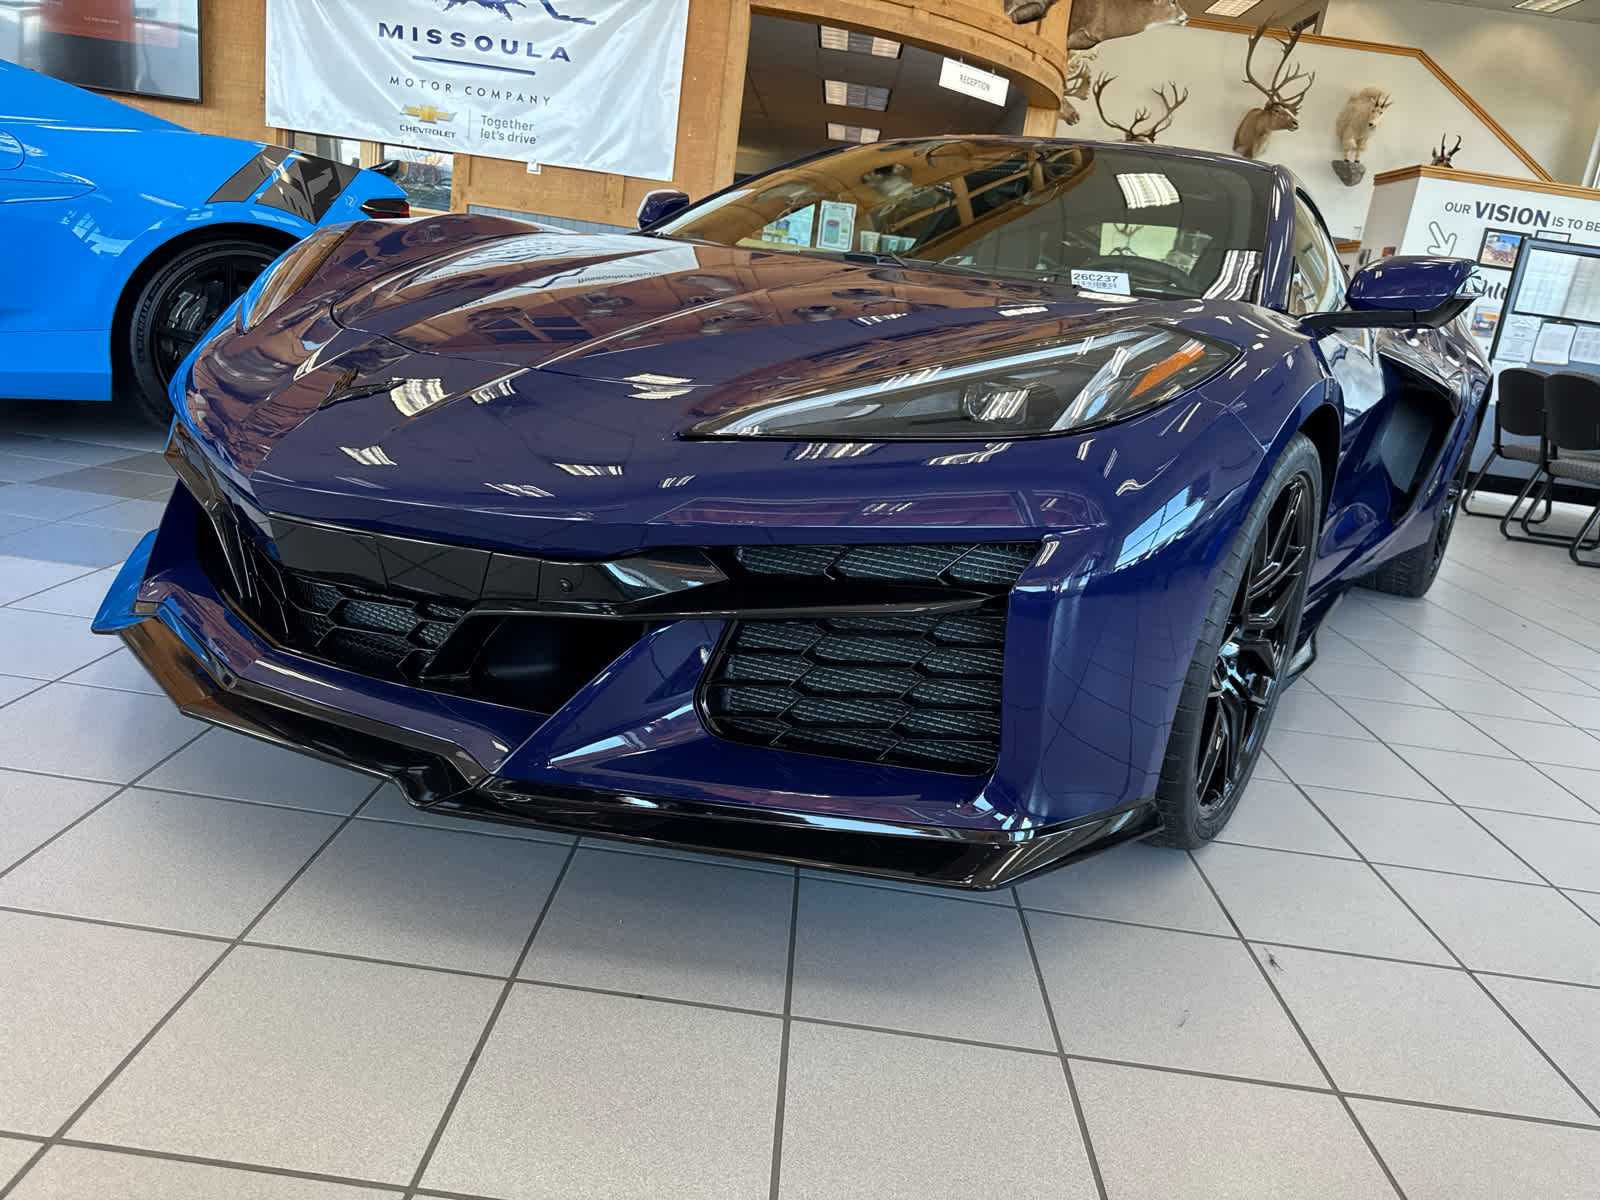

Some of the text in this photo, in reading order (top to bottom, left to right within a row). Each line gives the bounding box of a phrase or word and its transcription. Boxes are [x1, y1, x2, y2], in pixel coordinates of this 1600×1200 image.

[378, 22, 571, 63] MISSOULA
[959, 73, 991, 91] RECEPTION
[389, 76, 551, 106] MOTOR COMPANY
[399, 124, 457, 139] CHEVROLET
[480, 115, 535, 132] Together
[480, 128, 537, 145] let's drive
[1444, 201, 1471, 214] OUR
[1475, 201, 1551, 228] VISION
[1552, 216, 1564, 227] IS
[1567, 218, 1583, 230] TO
[1073, 272, 1119, 283] 26C237
